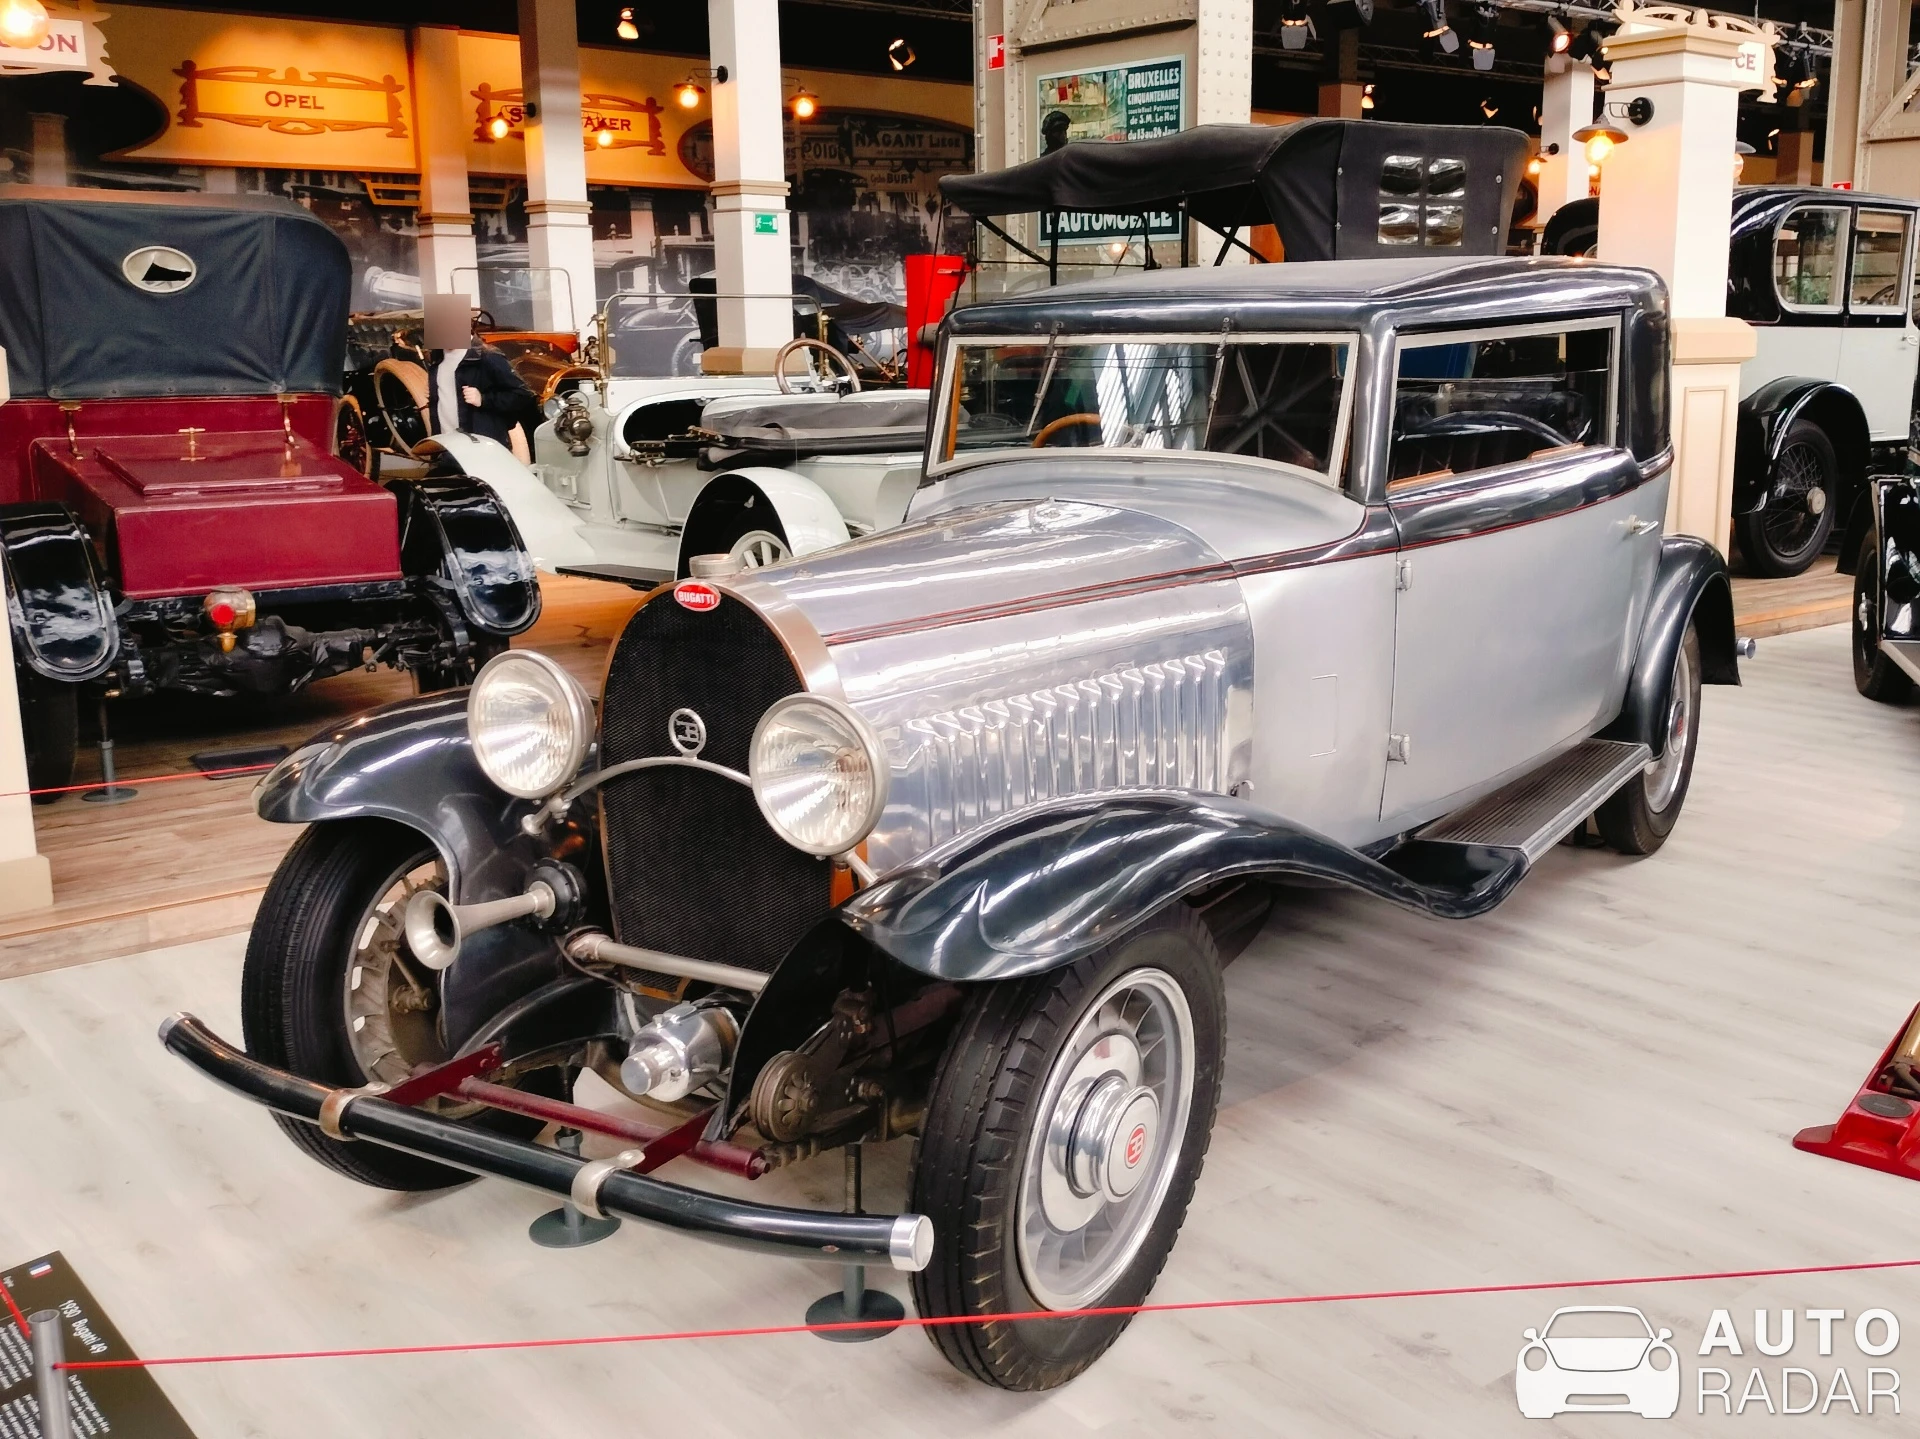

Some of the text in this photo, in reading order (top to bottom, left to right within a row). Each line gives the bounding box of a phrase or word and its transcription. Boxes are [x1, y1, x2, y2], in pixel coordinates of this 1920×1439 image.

[1128, 68, 1179, 90] BRUXELLES
[1128, 88, 1179, 105] CINQUANTENAIRE
[1130, 116, 1138, 125] de
[1155, 113, 1163, 122] Le
[1164, 111, 1176, 121] Roi
[1128, 130, 1136, 140] du
[1046, 211, 1172, 233] LAUTOMOBLE
[677, 590, 715, 605] BUGATTI
[59, 1299, 82, 1319] 1930
[72, 1318, 102, 1346] Bugatti
[89, 1342, 108, 1354] 49
